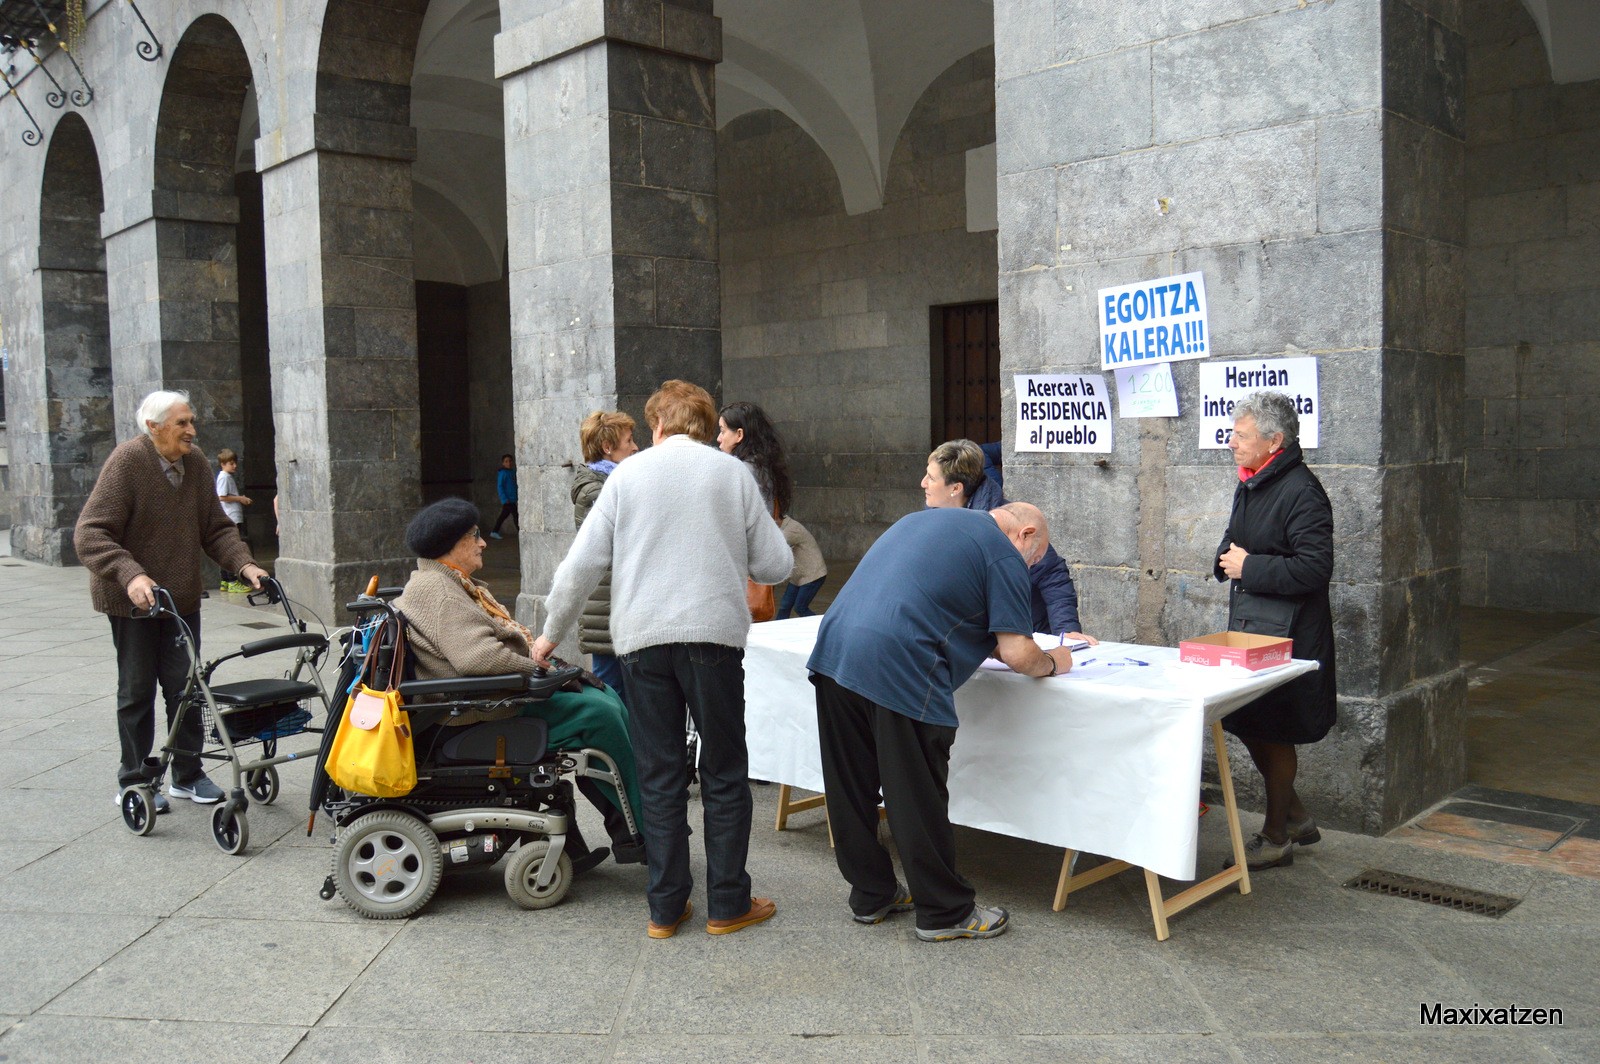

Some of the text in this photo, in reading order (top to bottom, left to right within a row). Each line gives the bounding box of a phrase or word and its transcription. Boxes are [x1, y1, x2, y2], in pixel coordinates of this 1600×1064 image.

[1105, 281, 1200, 326] EGOITZA
[1105, 320, 1205, 364] KALERA!!!
[1028, 378, 1095, 396] Acercar la
[1226, 364, 1288, 388] Herrian
[1021, 401, 1107, 420] RESIDENCIA
[1030, 425, 1097, 449] al pueblo
